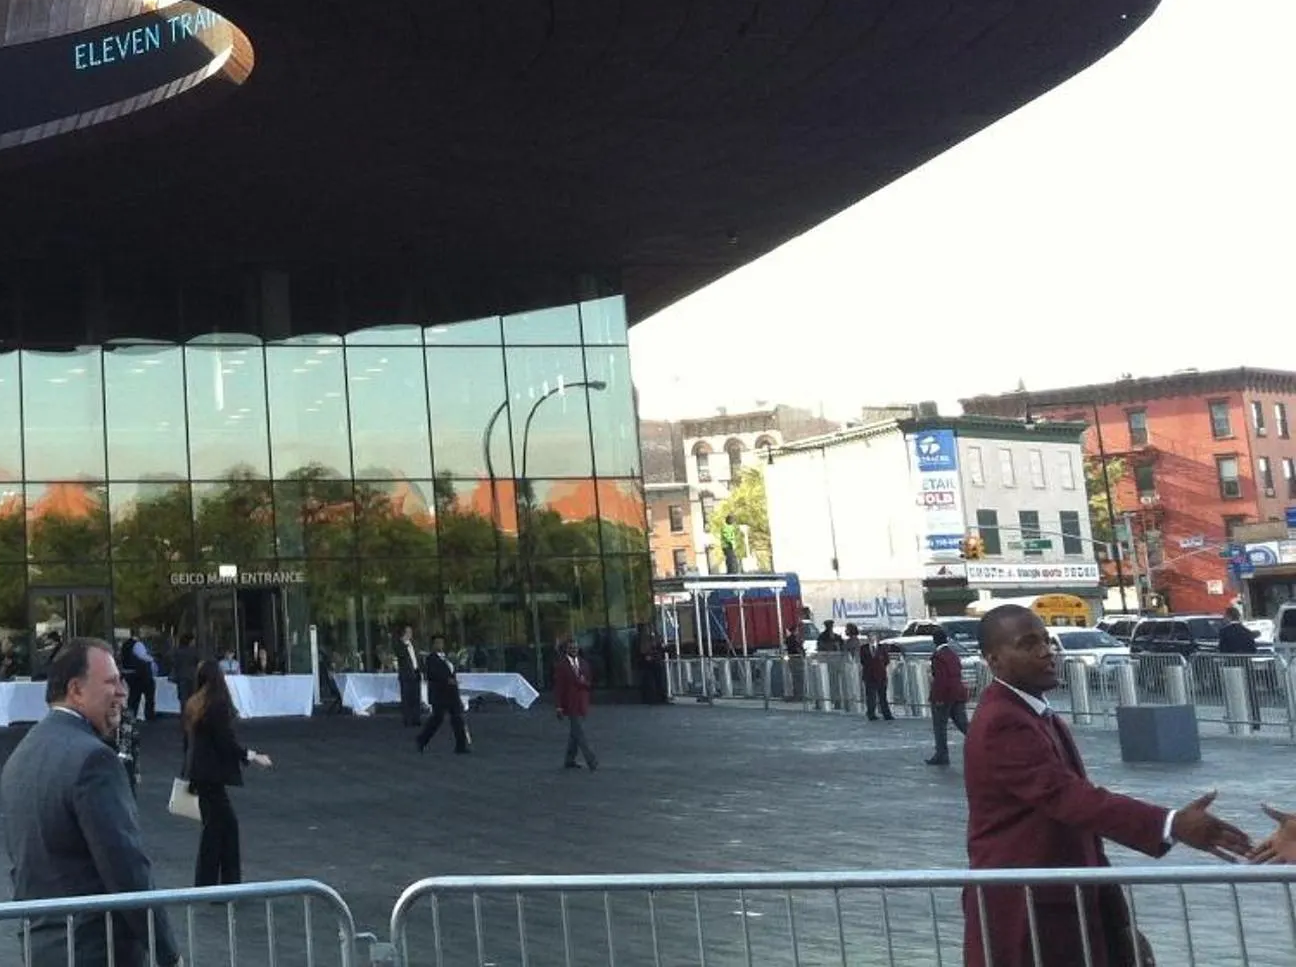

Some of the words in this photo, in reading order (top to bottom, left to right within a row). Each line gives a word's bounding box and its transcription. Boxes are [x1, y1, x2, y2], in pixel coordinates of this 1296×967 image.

[74, 23, 160, 70] ELEVEN
[170, 572, 205, 586] GEICO
[241, 571, 305, 585] ENTRANCE
